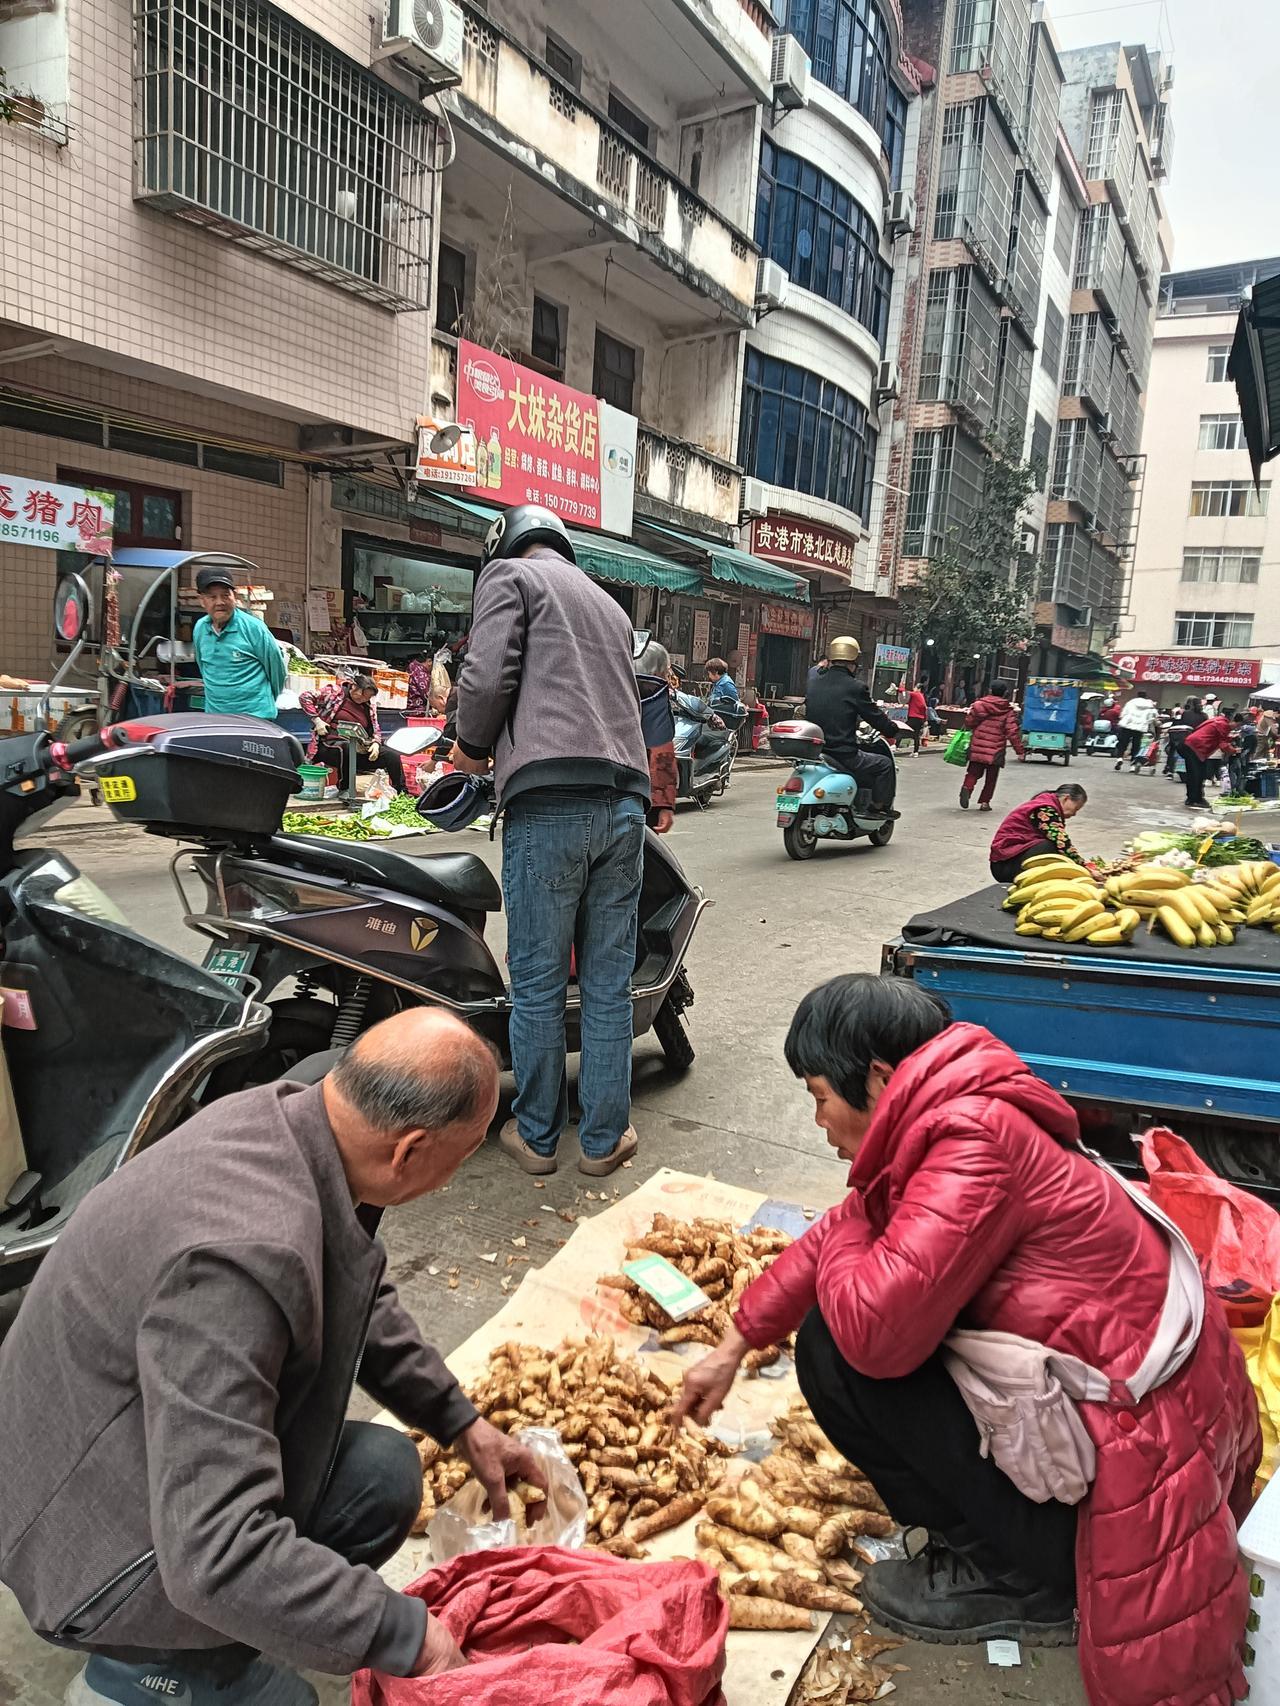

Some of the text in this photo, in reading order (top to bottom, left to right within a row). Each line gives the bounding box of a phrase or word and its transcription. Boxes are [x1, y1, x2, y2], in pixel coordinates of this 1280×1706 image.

[507, 377, 598, 461] 大妹杂货店
[0, 523, 60, 543] 8571196
[365, 916, 397, 935] 雅迪
